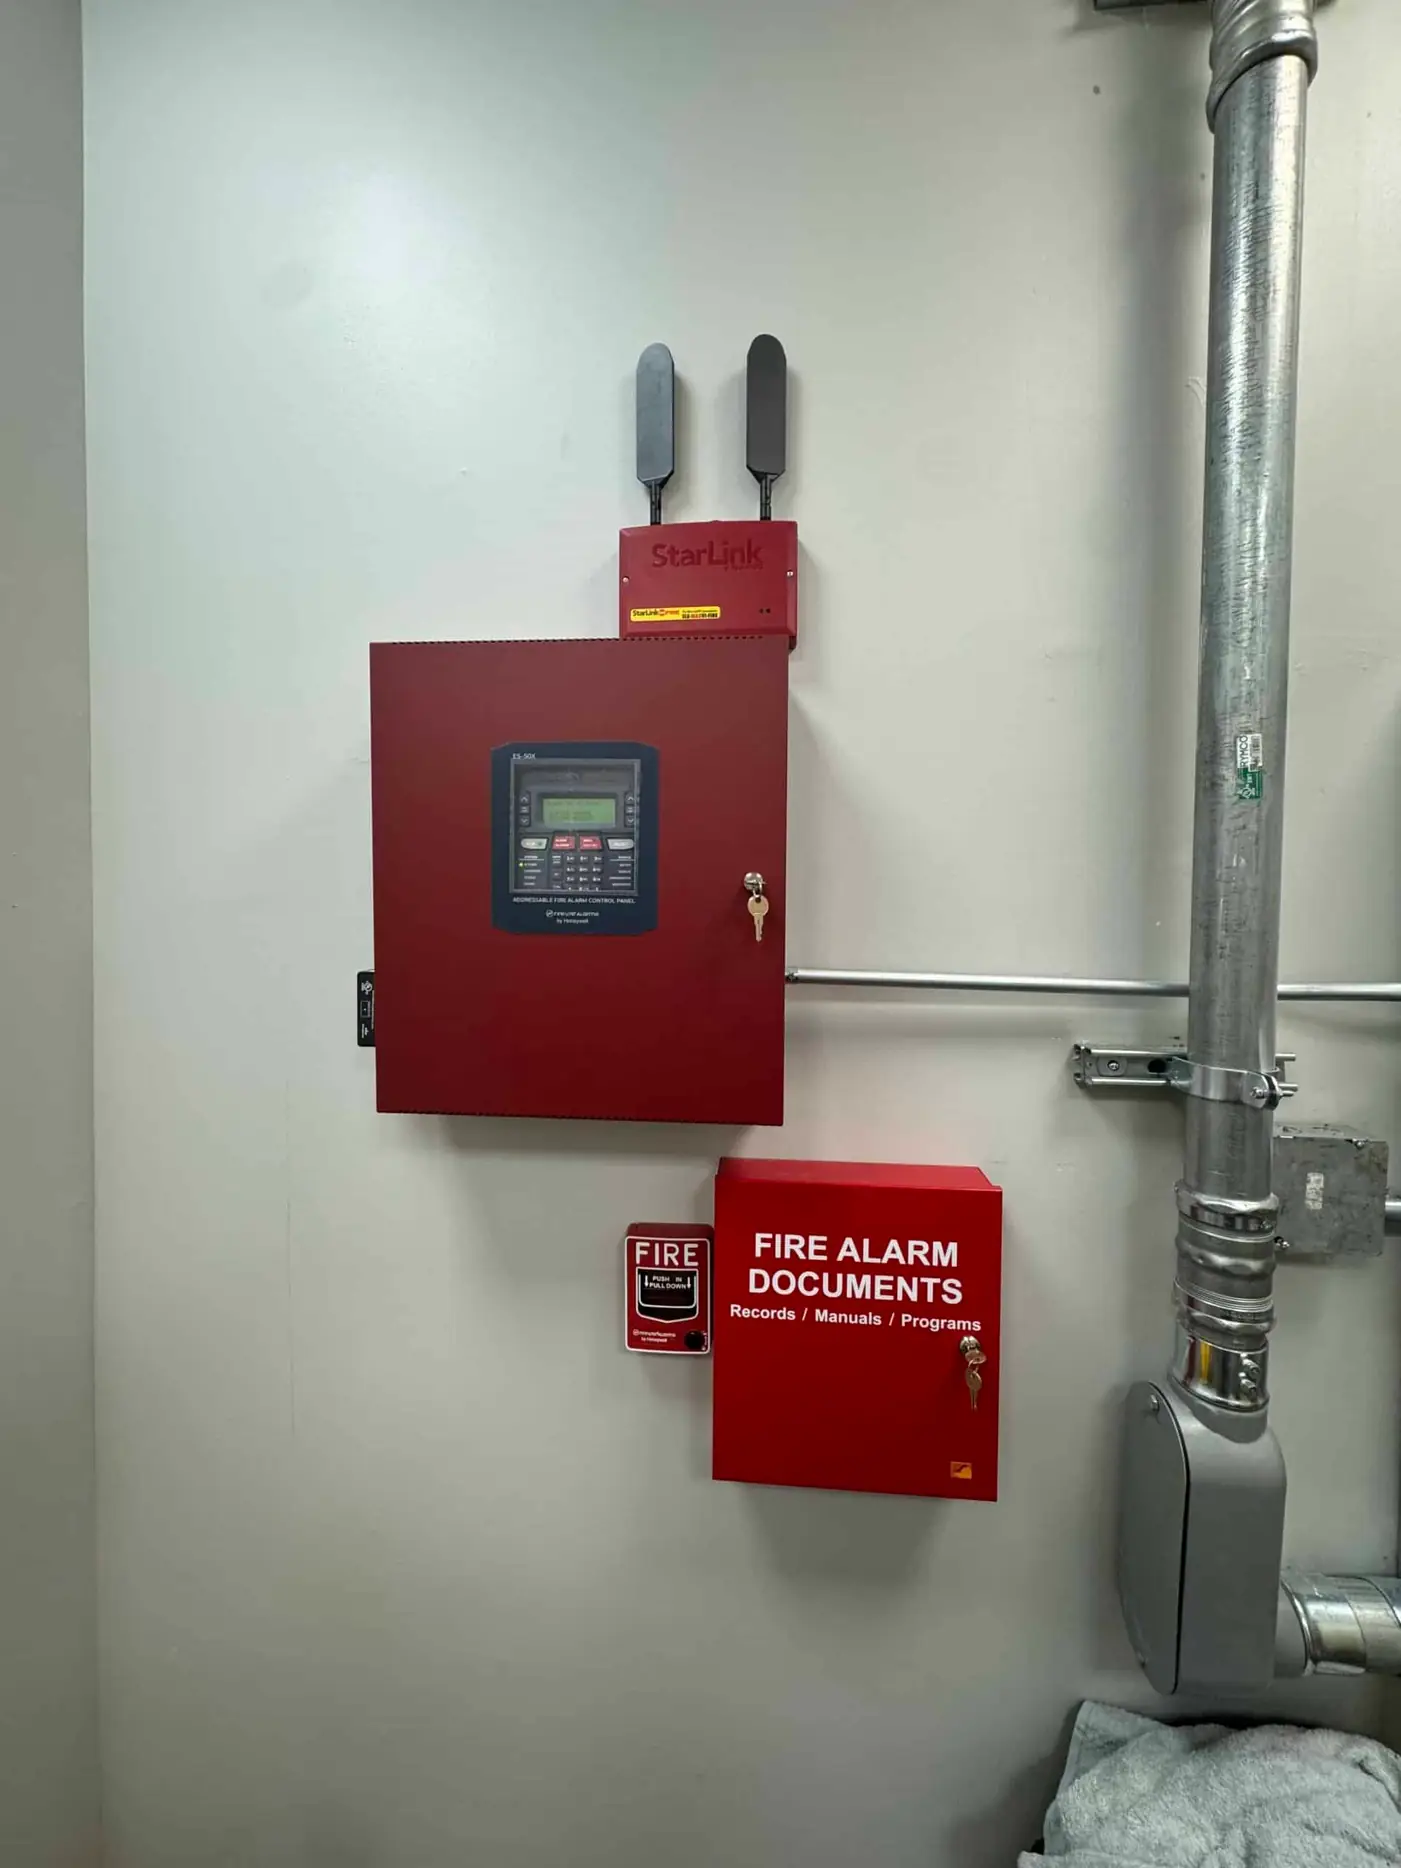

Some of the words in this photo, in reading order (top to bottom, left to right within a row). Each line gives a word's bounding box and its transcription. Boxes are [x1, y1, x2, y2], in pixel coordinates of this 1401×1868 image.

[652, 539, 763, 567] StarLink
[588, 897, 615, 905] CONTROL
[635, 1241, 699, 1267] FIRE
[754, 1233, 828, 1261] FIRE
[837, 1237, 958, 1267] ALARM
[749, 1269, 963, 1304] DOCUMENTS
[730, 1304, 796, 1321] Records
[815, 1308, 882, 1326] Manuals
[901, 1314, 982, 1333] Programs
